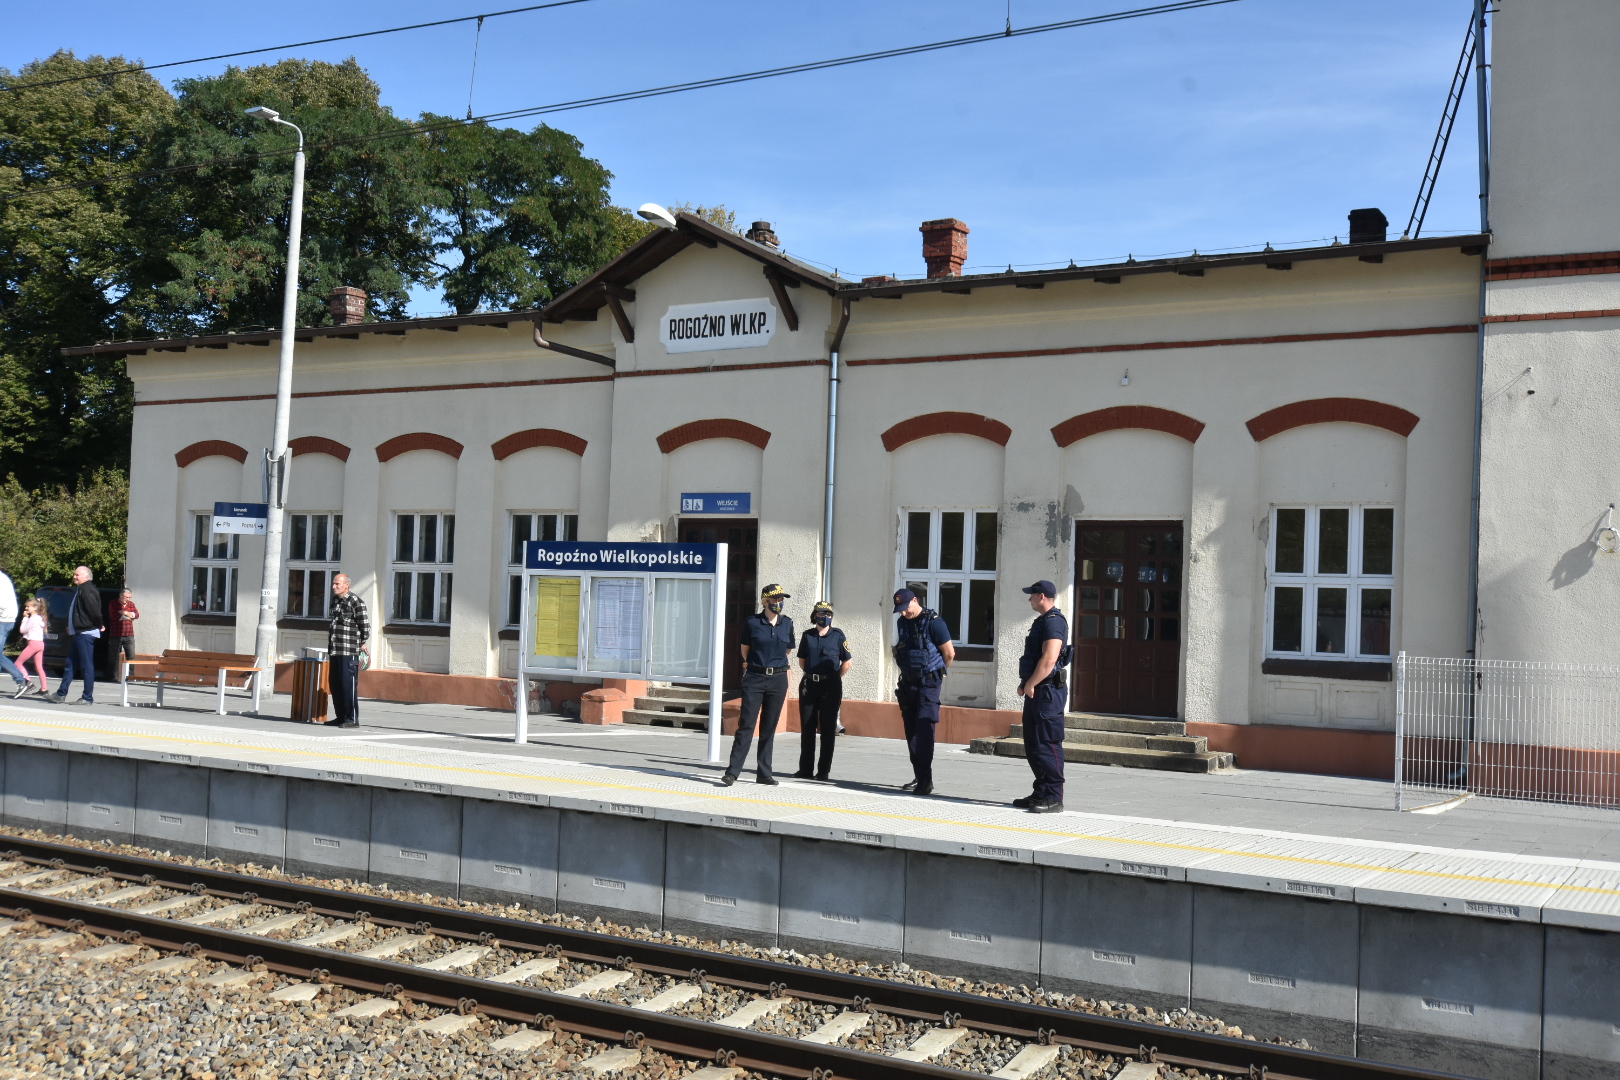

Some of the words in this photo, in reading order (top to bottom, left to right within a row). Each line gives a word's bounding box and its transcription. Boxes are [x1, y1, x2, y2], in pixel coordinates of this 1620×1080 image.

[669, 314, 726, 341] ROGOŹNO
[730, 311, 770, 336] WLKP.
[537, 548, 598, 565] Rogoźno
[599, 549, 703, 567] Wielkopolskie
